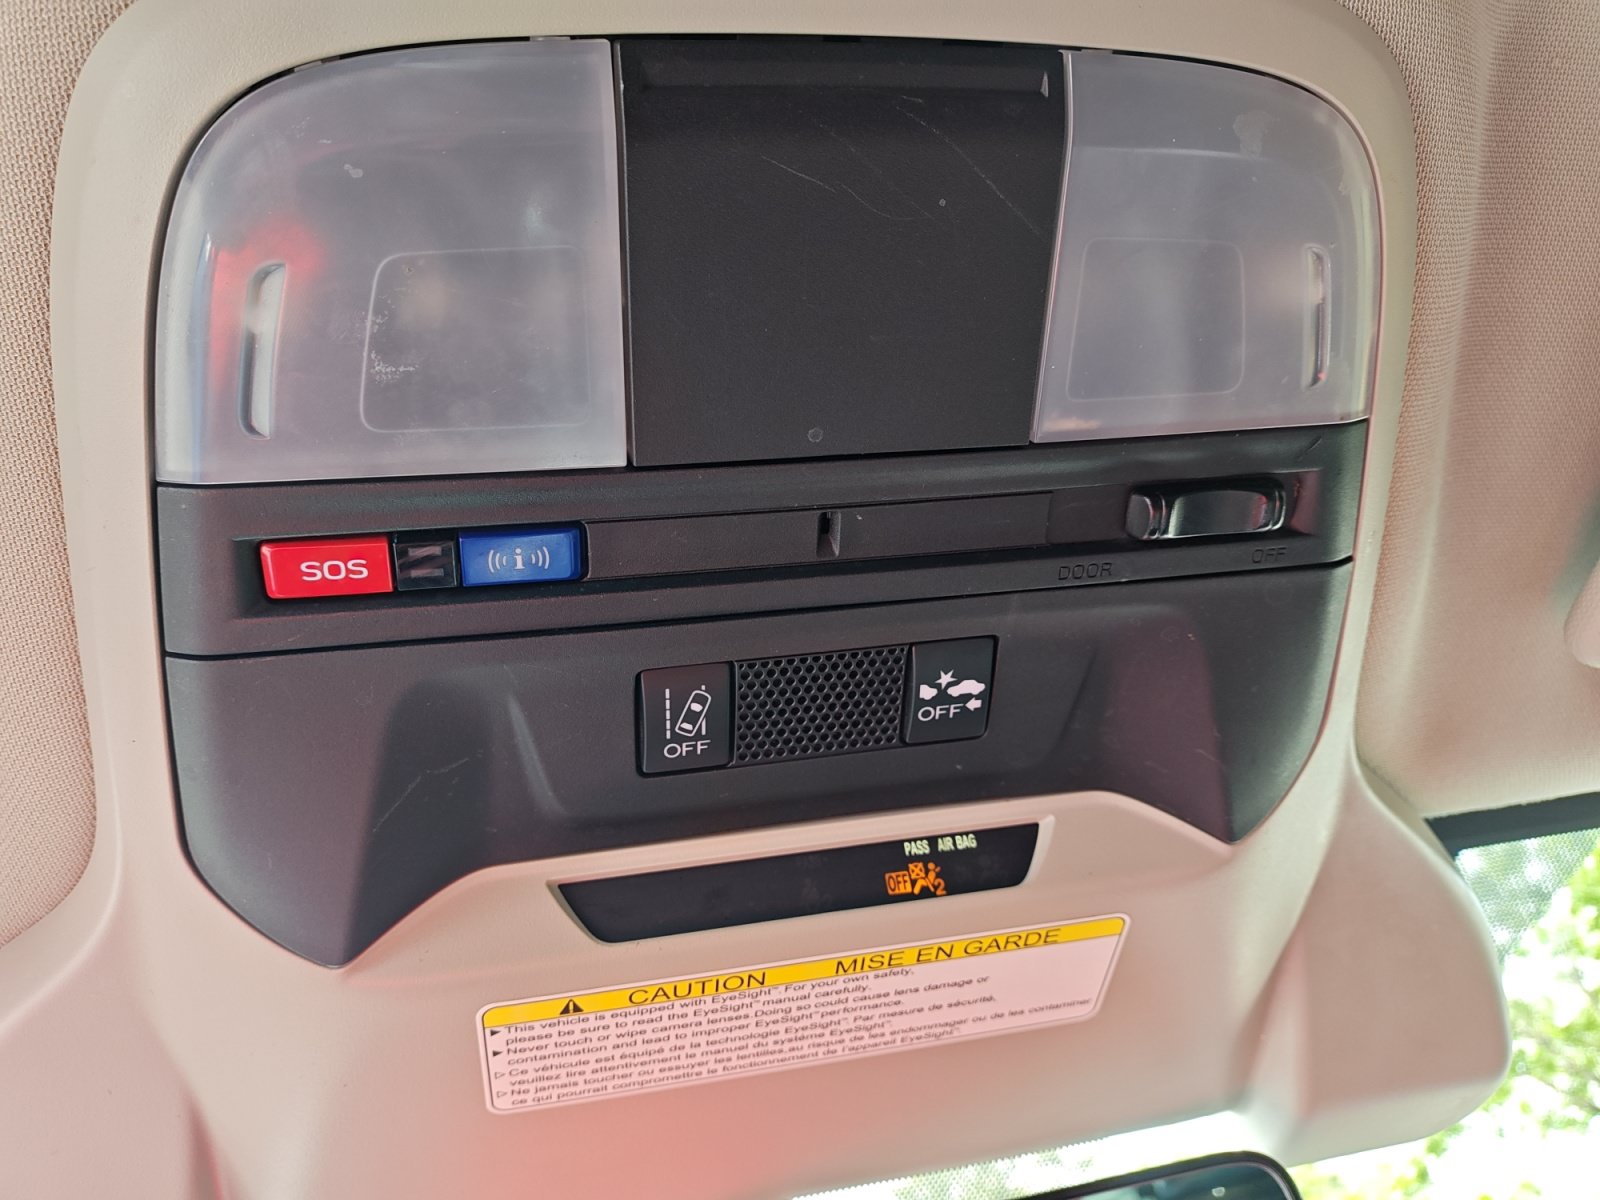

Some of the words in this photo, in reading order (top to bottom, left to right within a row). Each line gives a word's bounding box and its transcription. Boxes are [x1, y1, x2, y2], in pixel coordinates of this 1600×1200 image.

[300, 559, 368, 581] SOS
[1058, 563, 1113, 580] DOOR
[1252, 547, 1286, 564] OFF
[917, 704, 963, 722] OFF
[664, 740, 711, 758] OFF
[904, 840, 930, 856] PASS
[938, 836, 955, 852] AIR
[955, 834, 977, 849] BAG
[887, 873, 910, 892] OFF
[835, 951, 904, 975] MISE
[916, 944, 954, 963] EN
[964, 928, 1061, 955] GARDE
[504, 1025, 535, 1034] This
[540, 1016, 590, 1028] vehicle
[610, 1002, 674, 1018] equipped
[680, 997, 707, 1008] with
[785, 983, 805, 992] For
[810, 979, 839, 991] your
[842, 974, 869, 984] own
[628, 972, 766, 1004] CAUTION
[506, 1031, 552, 1046] please
[558, 1028, 575, 1036] be
[580, 1023, 610, 1033] sure
[615, 1019, 628, 1028] to
[635, 1015, 663, 1025] read
[668, 1009, 688, 1020] the
[762, 992, 810, 1006] manual
[815, 983, 871, 999] carefully.
[506, 1043, 550, 1055] Never
[554, 1035, 592, 1048] touch
[616, 1026, 647, 1040] wipe
[652, 1021, 702, 1033] camera
[815, 996, 848, 1008] could
[852, 991, 890, 1002] cause
[894, 986, 920, 996] lens
[923, 977, 973, 992] damage
[508, 1044, 608, 1065] contamination
[612, 1040, 637, 1049] and
[642, 1034, 670, 1045] lead
[675, 1032, 687, 1040] to
[692, 1022, 751, 1039] improper
[509, 1067, 529, 1077] Ce
[533, 1059, 590, 1072] véhicule
[595, 1054, 615, 1063] est
[620, 1047, 665, 1061] équipé
[669, 1042, 685, 1051] de
[690, 1040, 701, 1048] la
[706, 1030, 780, 1046] technologie
[853, 1013, 874, 1023] Par
[878, 1006, 924, 1019] mesure
[509, 1074, 561, 1086] veuillez
[566, 1069, 586, 1078] lire
[591, 1054, 681, 1070] attentivement
[701, 1042, 749, 1057] manuel
[753, 1039, 769, 1047] du
[511, 1087, 530, 1096] Ne
[534, 1079, 579, 1094] jamais
[583, 1072, 633, 1086] toucher
[638, 1068, 654, 1077] ou
[659, 1059, 711, 1073] essuyer
[714, 1055, 732, 1064] les
[808, 1037, 845, 1050] risque
[850, 1033, 864, 1041] de
[868, 1030, 885, 1039] les
[890, 1018, 969, 1035] endommager
[972, 1014, 987, 1023] ou
[991, 1011, 1004, 1019] de
[512, 1097, 528, 1106] ce
[532, 1092, 552, 1104] qui
[557, 1085, 608, 1100] pourrait
[612, 1070, 703, 1089] compromettre
[722, 1050, 818, 1072] fonctionnement
[823, 1048, 838, 1057] de
